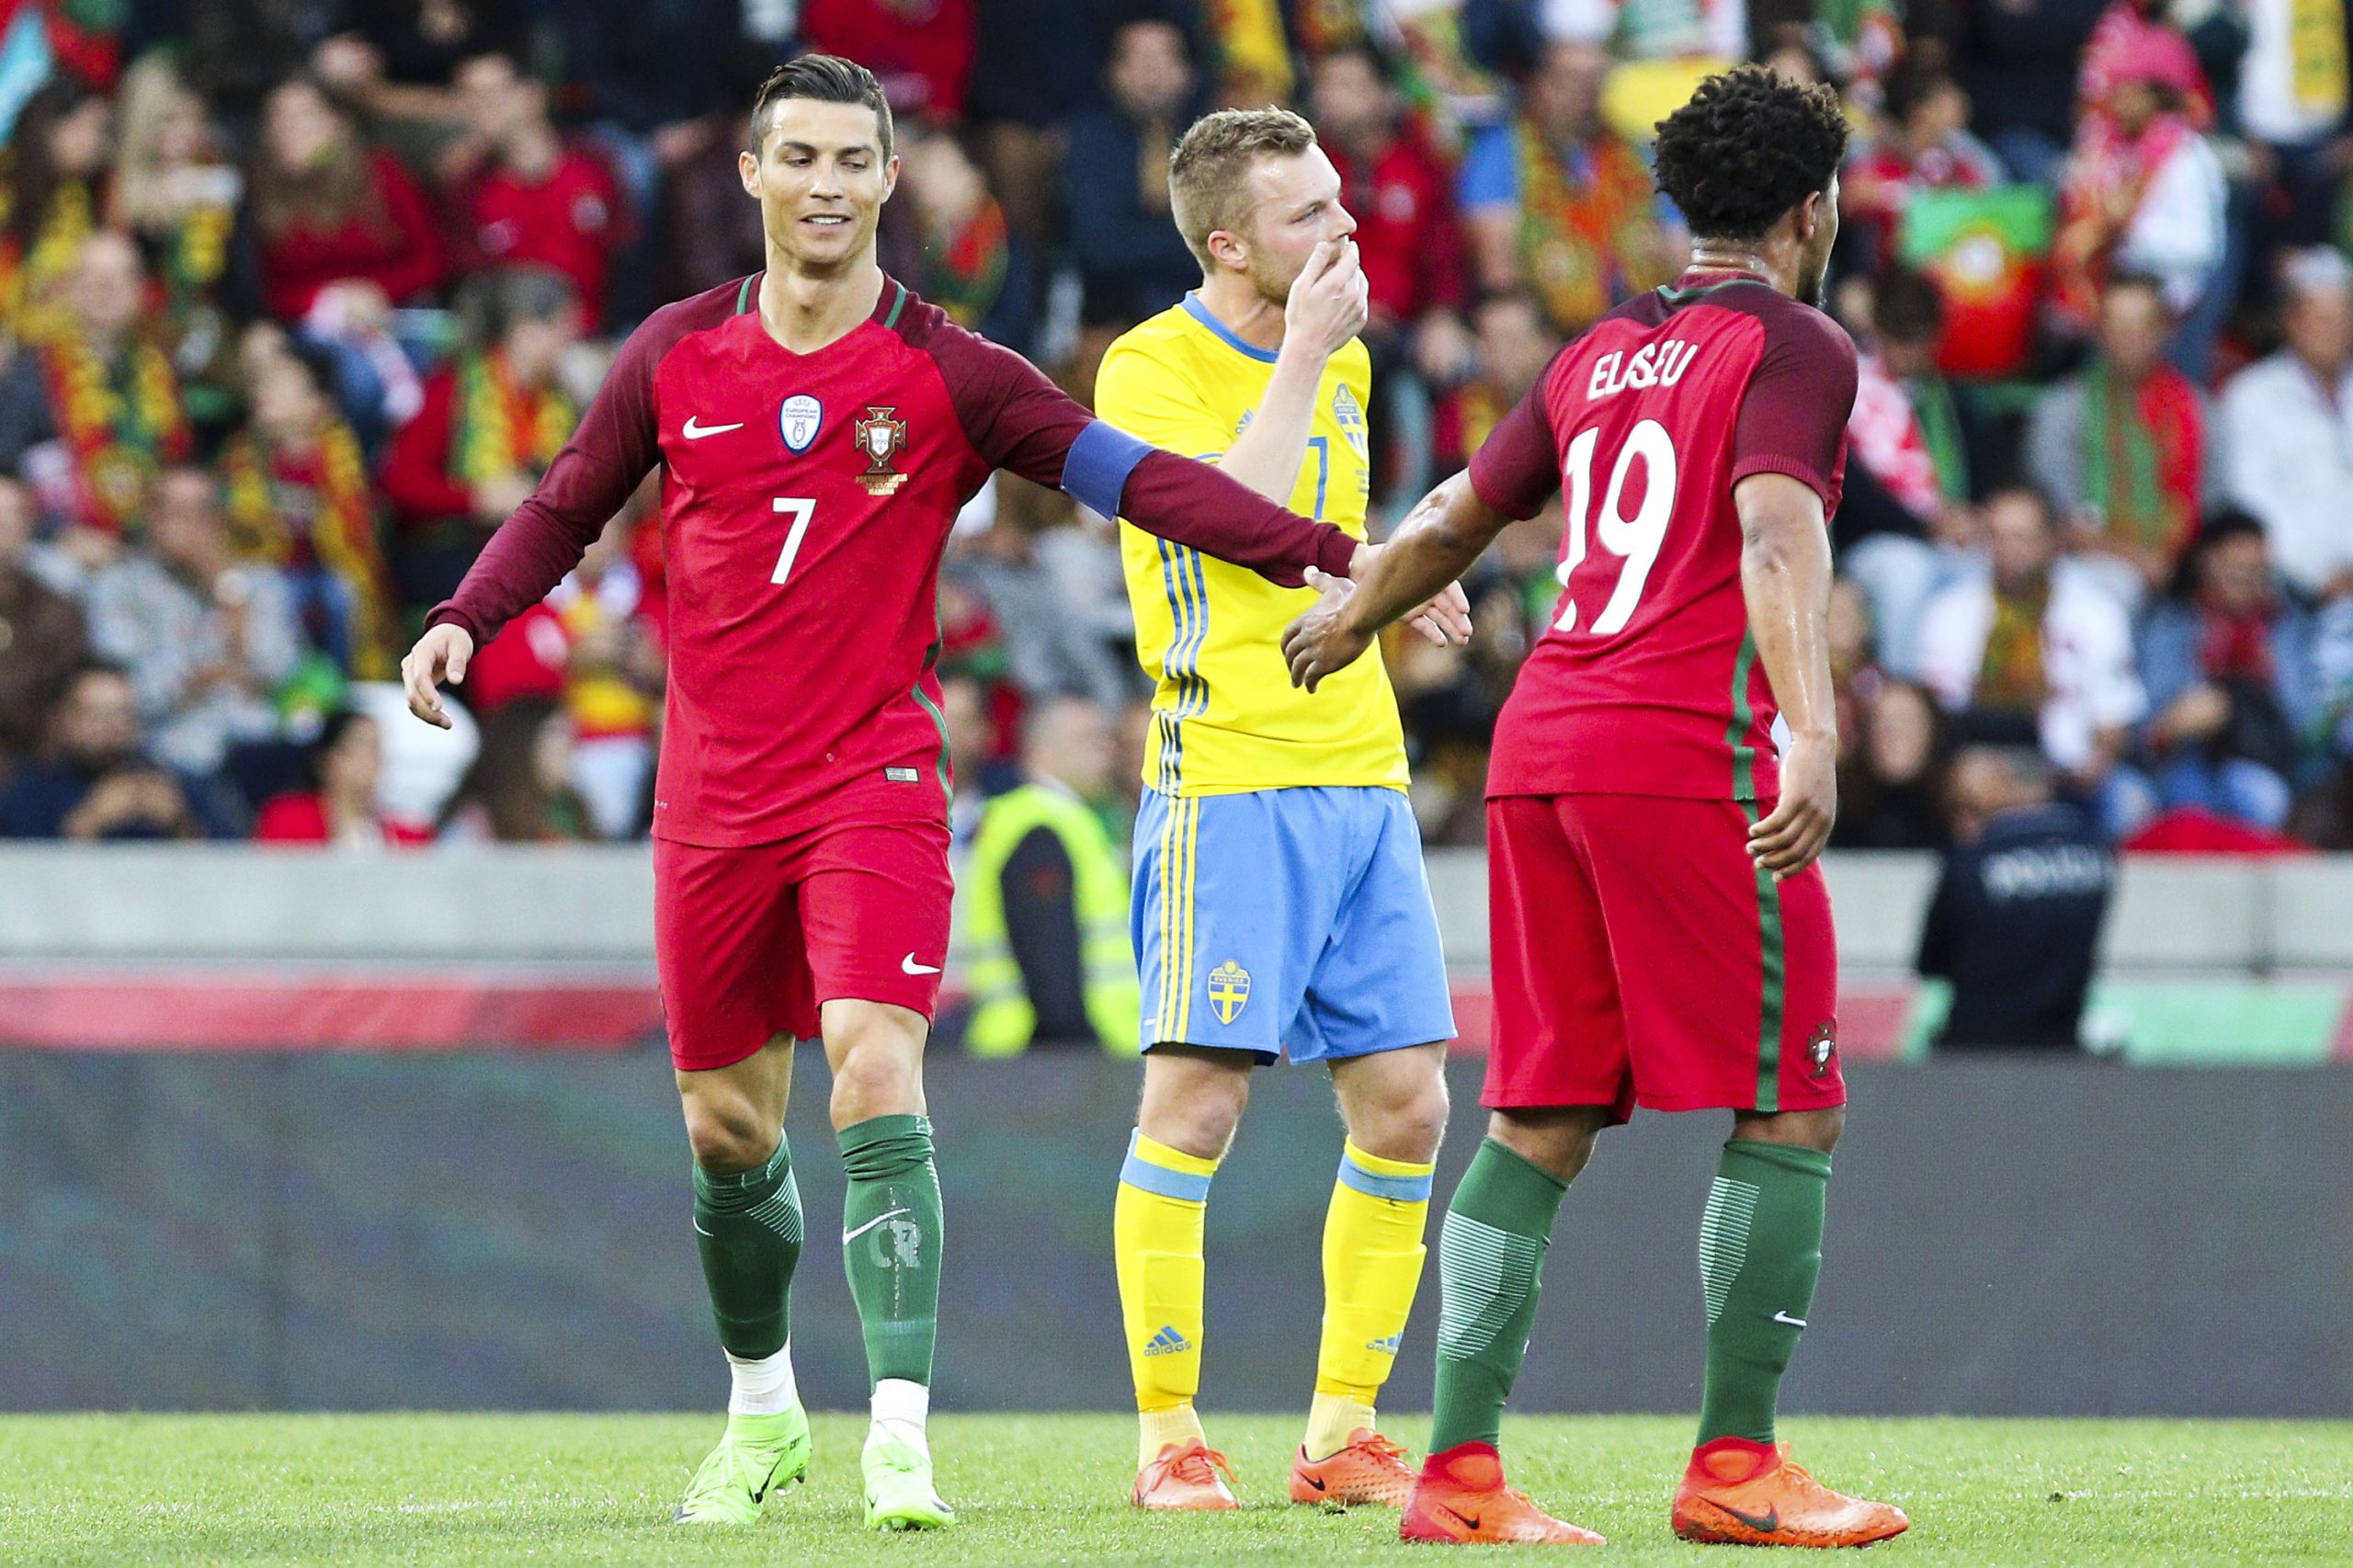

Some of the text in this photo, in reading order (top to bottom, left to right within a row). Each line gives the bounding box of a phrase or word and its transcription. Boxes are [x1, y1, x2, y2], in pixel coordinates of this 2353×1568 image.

[770, 497, 817, 585] 7
[1551, 419, 1677, 635] 19
[1143, 1340, 1192, 1357] adidas
